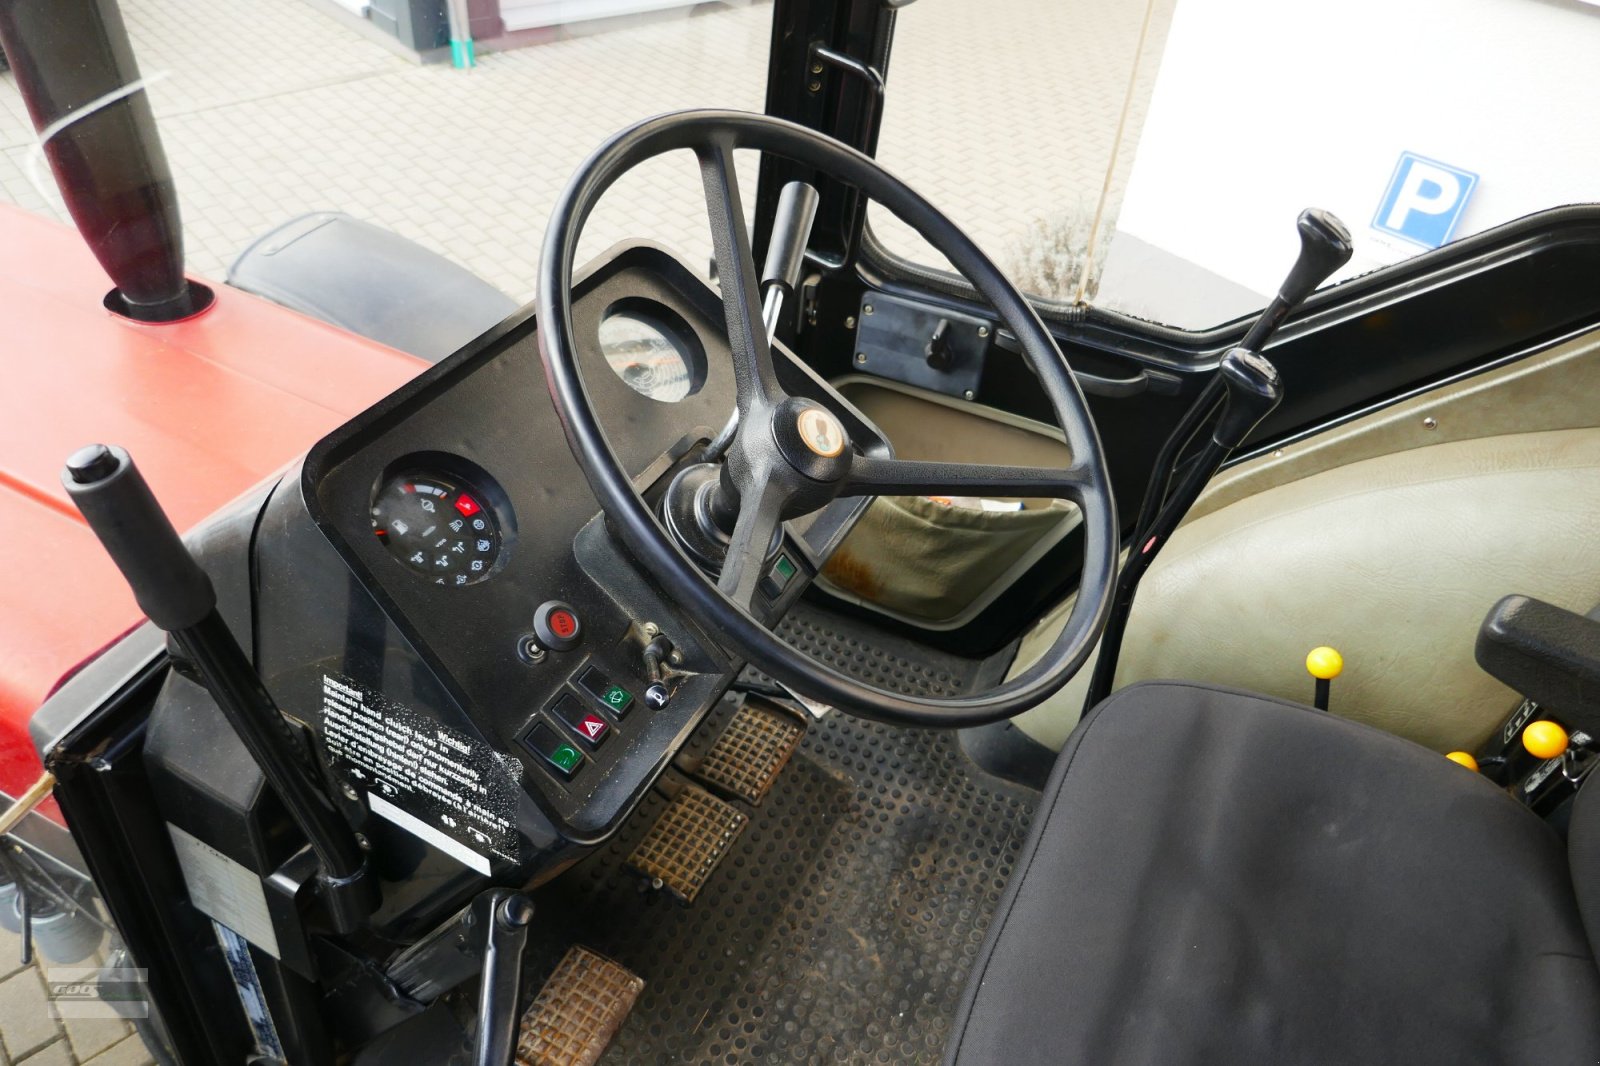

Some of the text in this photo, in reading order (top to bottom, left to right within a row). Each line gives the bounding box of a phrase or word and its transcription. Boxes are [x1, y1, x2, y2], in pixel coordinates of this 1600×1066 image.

[1386, 160, 1460, 230] P
[323, 684, 448, 754] Maintain hand clutch lever in
[353, 709, 384, 733] position
[410, 737, 427, 756] only
[438, 730, 470, 755] Wichtig!
[363, 754, 373, 764] en
[375, 760, 409, 783] position
[406, 747, 422, 763] darf
[423, 757, 437, 770] nur
[479, 784, 486, 795] in
[404, 766, 416, 779] de
[418, 774, 462, 803] commande
[473, 802, 494, 820] main
[497, 816, 509, 828] ne
